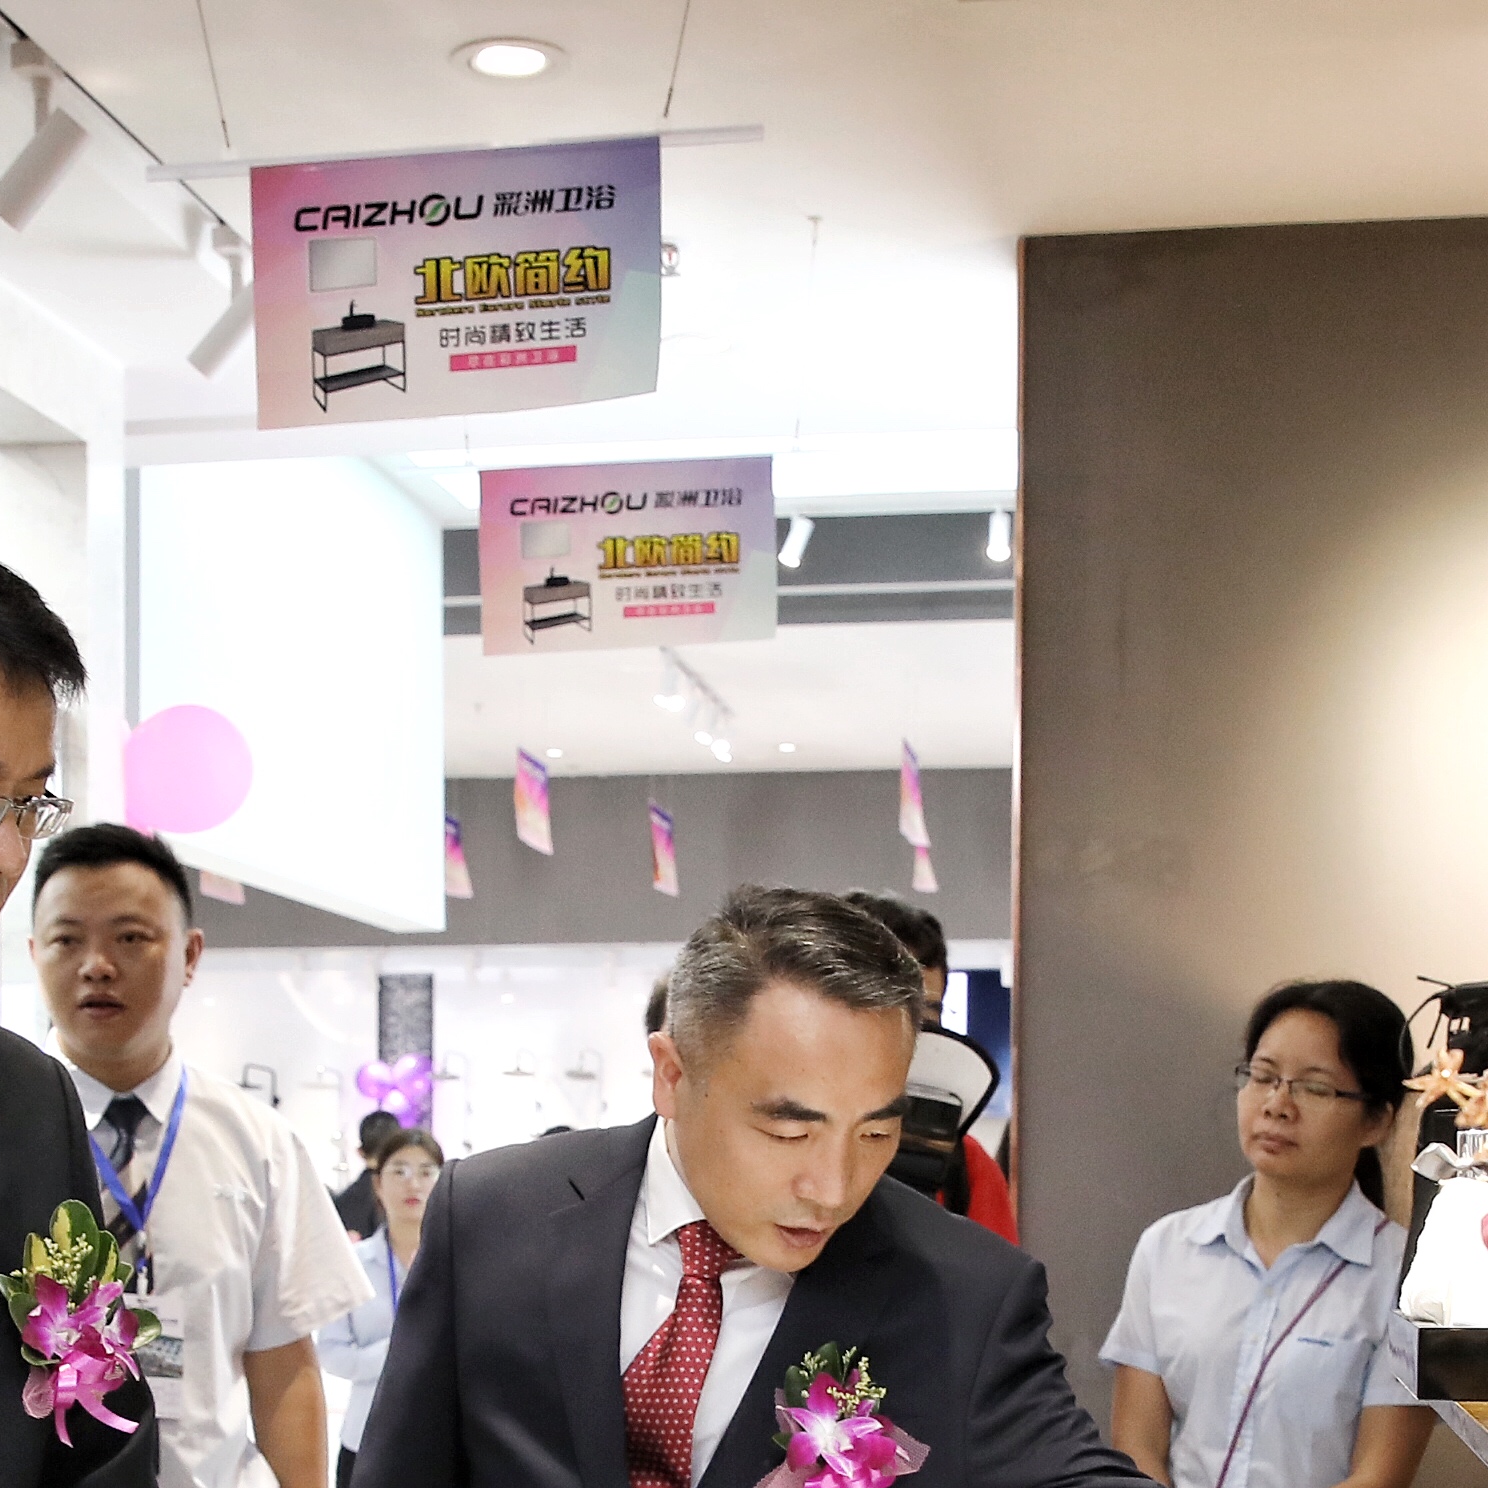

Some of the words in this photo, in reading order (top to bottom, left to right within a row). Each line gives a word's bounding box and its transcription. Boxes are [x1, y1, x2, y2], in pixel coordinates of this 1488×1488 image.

[294, 193, 485, 231] CAIZHOU
[414, 245, 612, 304] 北欧简约
[439, 317, 587, 348] 时尚精致生活
[510, 491, 648, 515] CAIZHOU
[597, 531, 740, 569] 北欧简约
